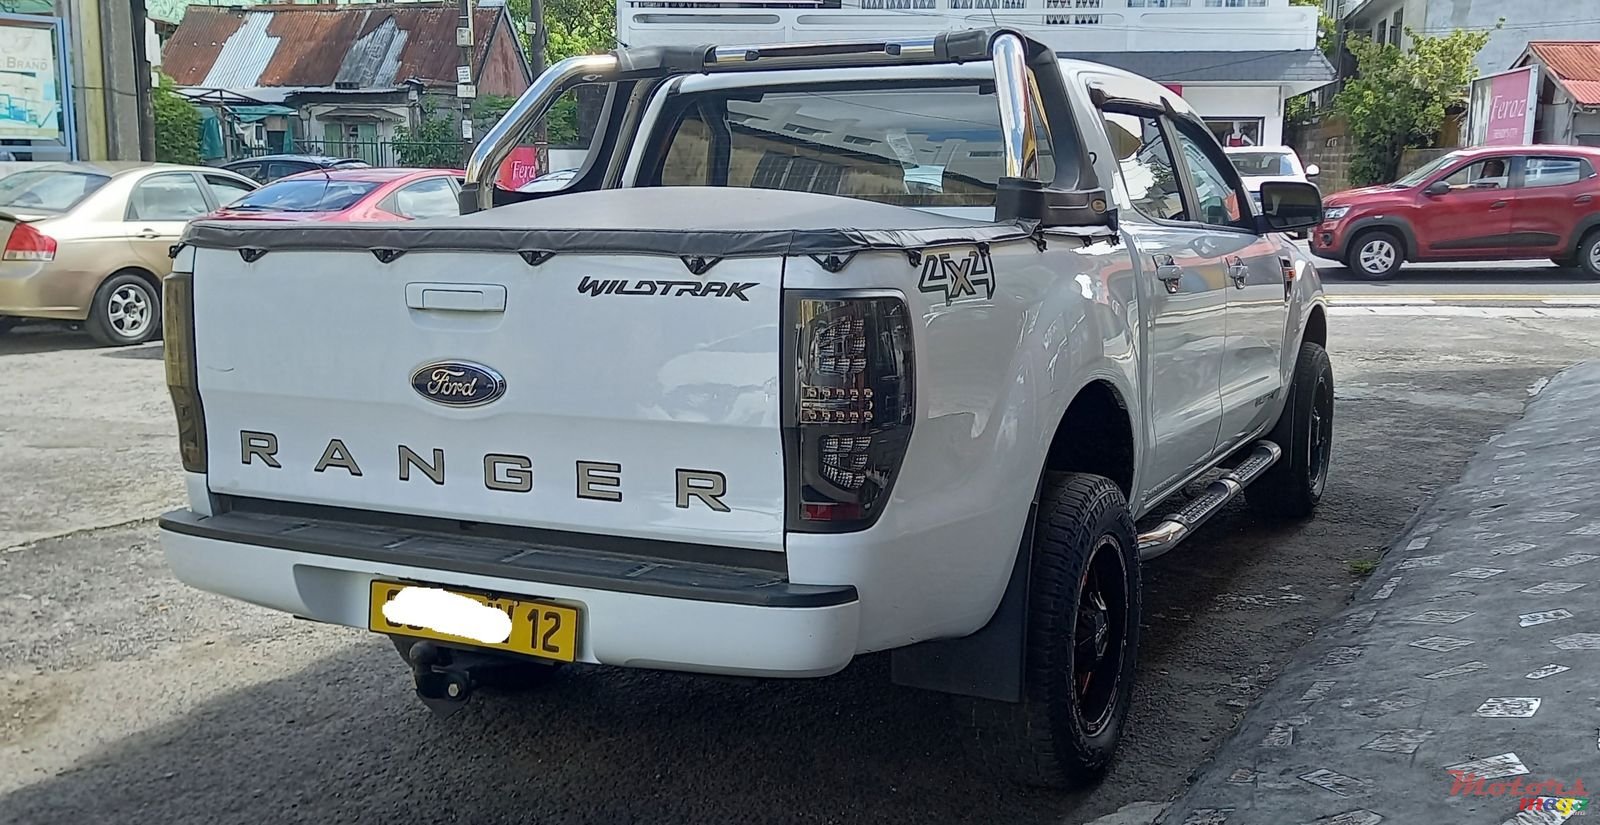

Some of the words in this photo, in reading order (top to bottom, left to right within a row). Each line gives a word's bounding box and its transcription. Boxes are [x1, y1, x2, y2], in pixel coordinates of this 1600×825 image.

[1490, 95, 1527, 123] Feraz
[511, 160, 536, 181] Fera
[577, 275, 761, 302] WILDTRAK
[426, 368, 478, 397] Ford
[240, 429, 732, 513] RANGER
[527, 608, 562, 653] 12
